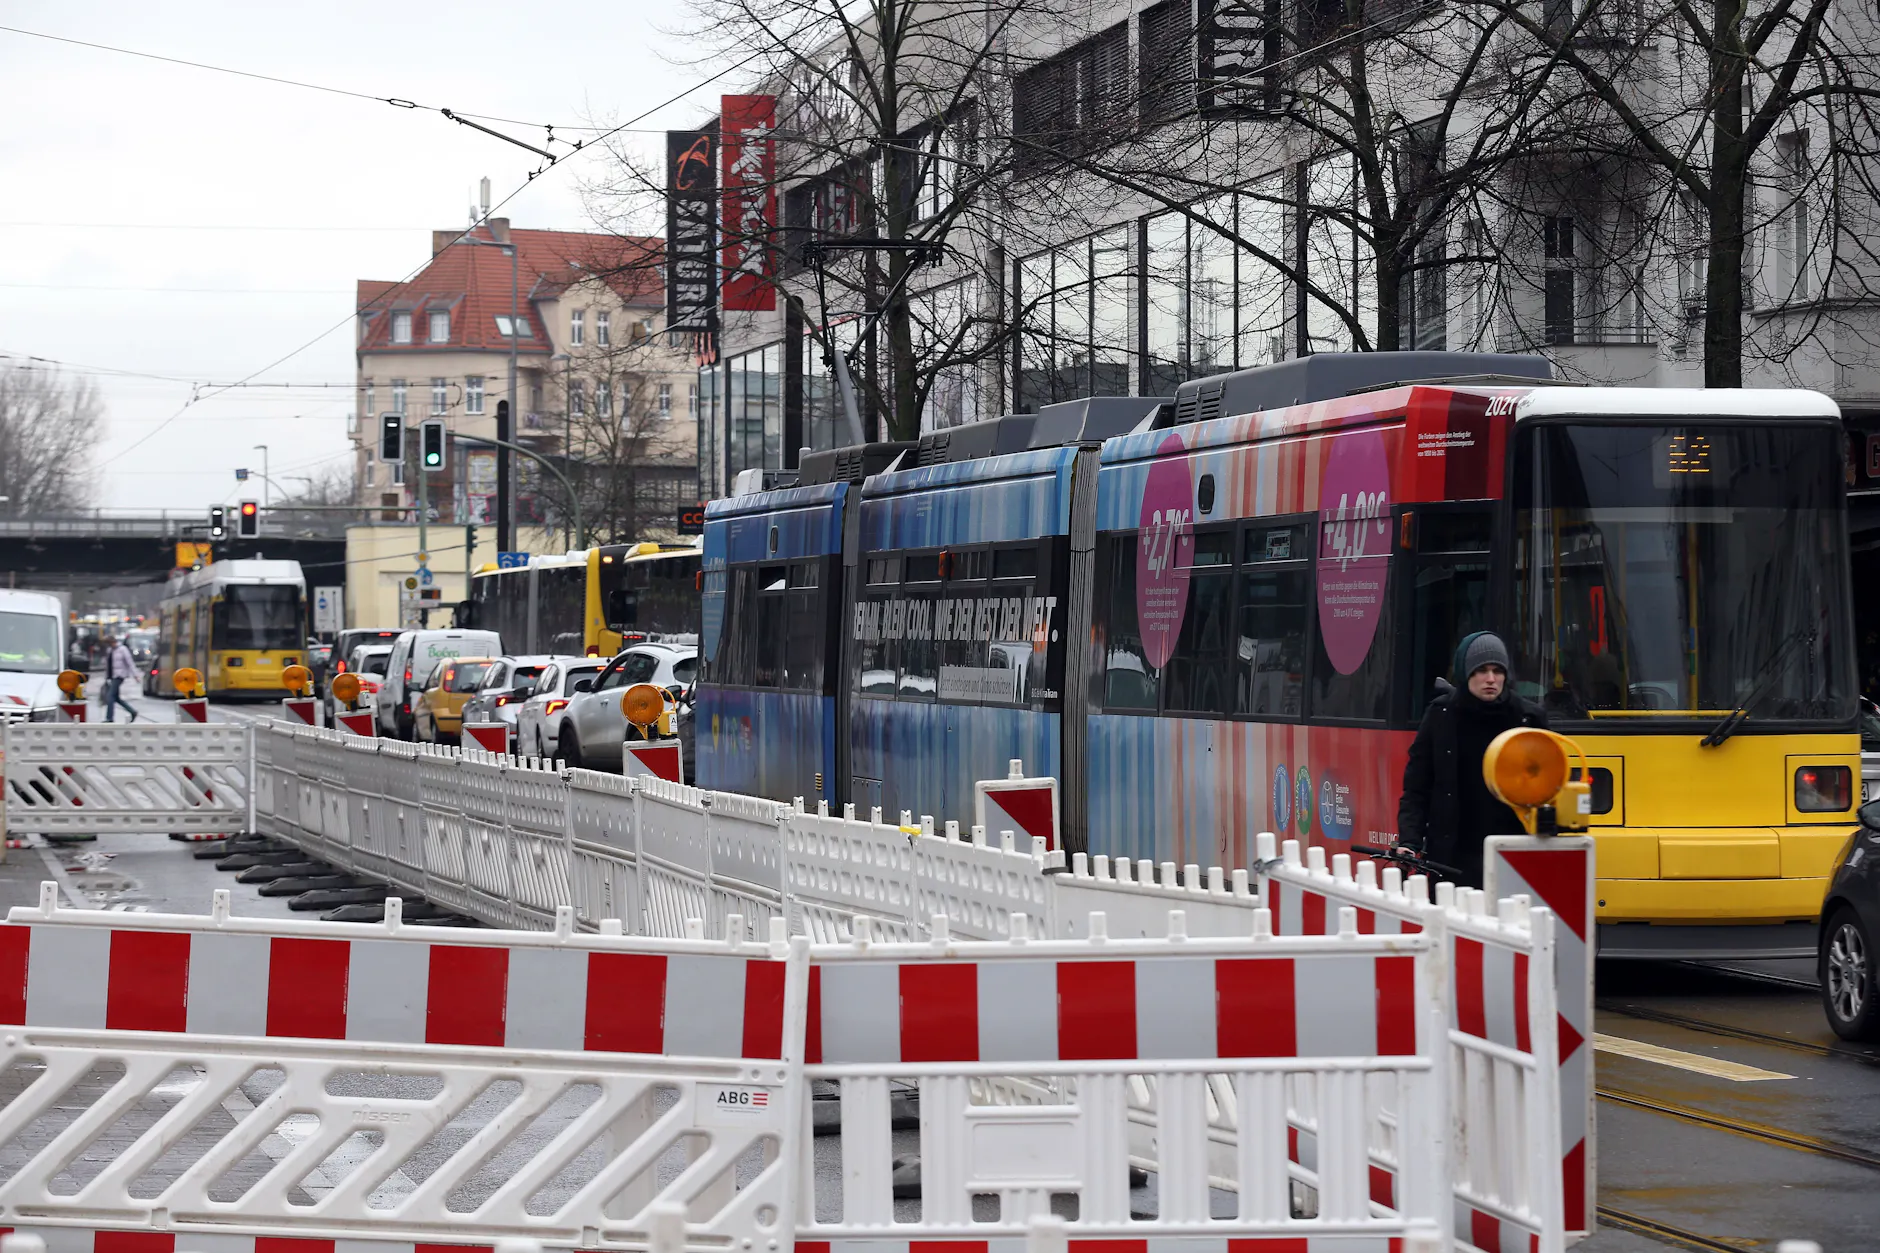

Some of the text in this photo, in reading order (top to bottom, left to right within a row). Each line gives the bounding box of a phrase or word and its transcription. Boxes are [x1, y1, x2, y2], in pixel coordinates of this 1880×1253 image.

[676, 199, 708, 328] SATURN
[1485, 396, 1518, 417] 2021
[882, 600, 907, 640] BLEIB
[907, 598, 932, 640] COOL.
[934, 599, 954, 640] WIE
[953, 598, 974, 640] DER
[974, 598, 1000, 640] REST
[1000, 597, 1022, 641] DER
[1022, 596, 1059, 642] WELT.
[717, 1091, 750, 1104] ABG
